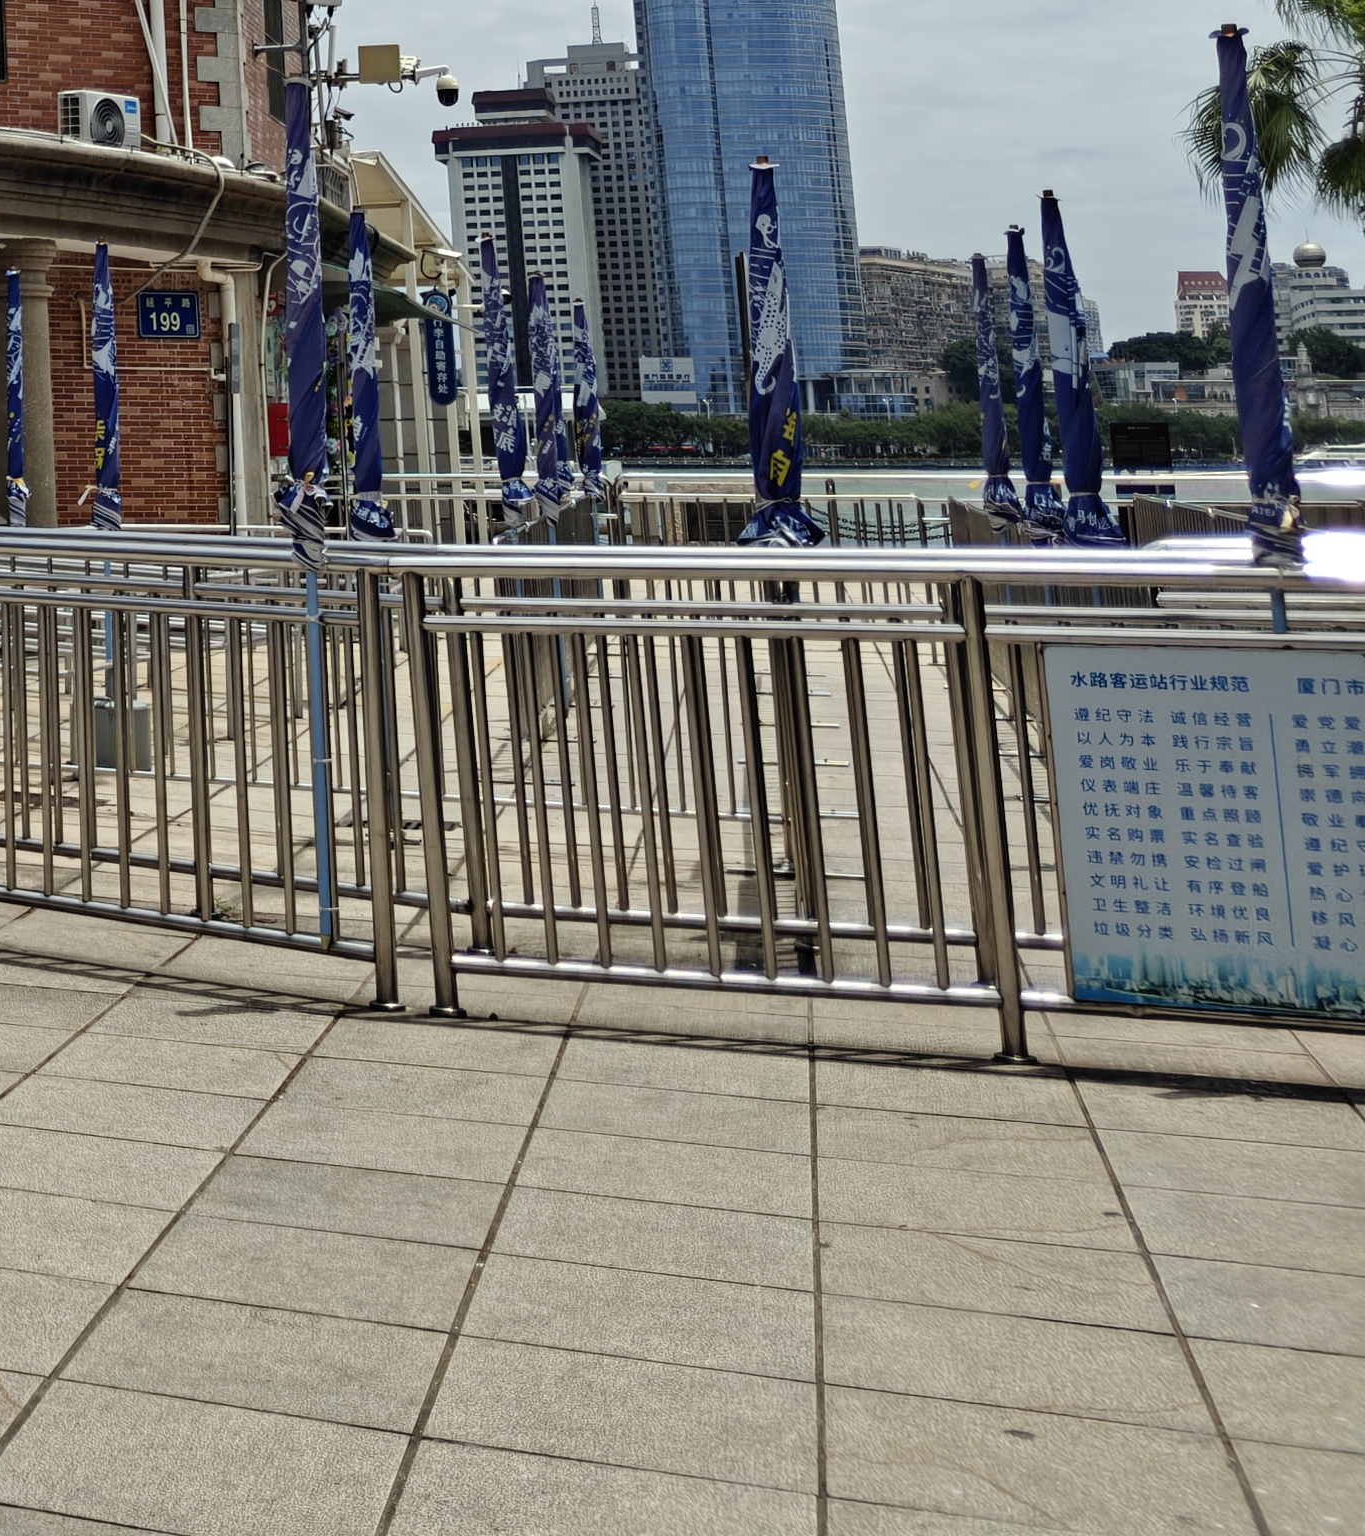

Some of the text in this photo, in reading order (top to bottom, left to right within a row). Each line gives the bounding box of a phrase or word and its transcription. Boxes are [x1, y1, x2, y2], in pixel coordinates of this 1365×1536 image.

[149, 311, 181, 331] 199
[1070, 671, 1250, 693] 水路客运站行业规范
[1297, 677, 1365, 695] 厦门市
[1074, 707, 1252, 727] 遵纪守法 诚信经营
[1077, 731, 1254, 751] 以人为本 践行宗旨
[1079, 755, 1257, 775] 爱岗敬业 乐于奉献
[1081, 778, 1259, 800] 仪表端庄 温馨待客
[1083, 802, 1163, 820] 优抚对象
[1085, 826, 1264, 849] 实名购票 实名查验
[1087, 849, 1168, 868] 违禁勿携
[1089, 873, 1269, 897] 文明礼让 有序登船
[1310, 886, 1365, 902] 热心
[1092, 898, 1172, 916] 卫生整洁
[1094, 921, 1174, 940] 垃圾分类
